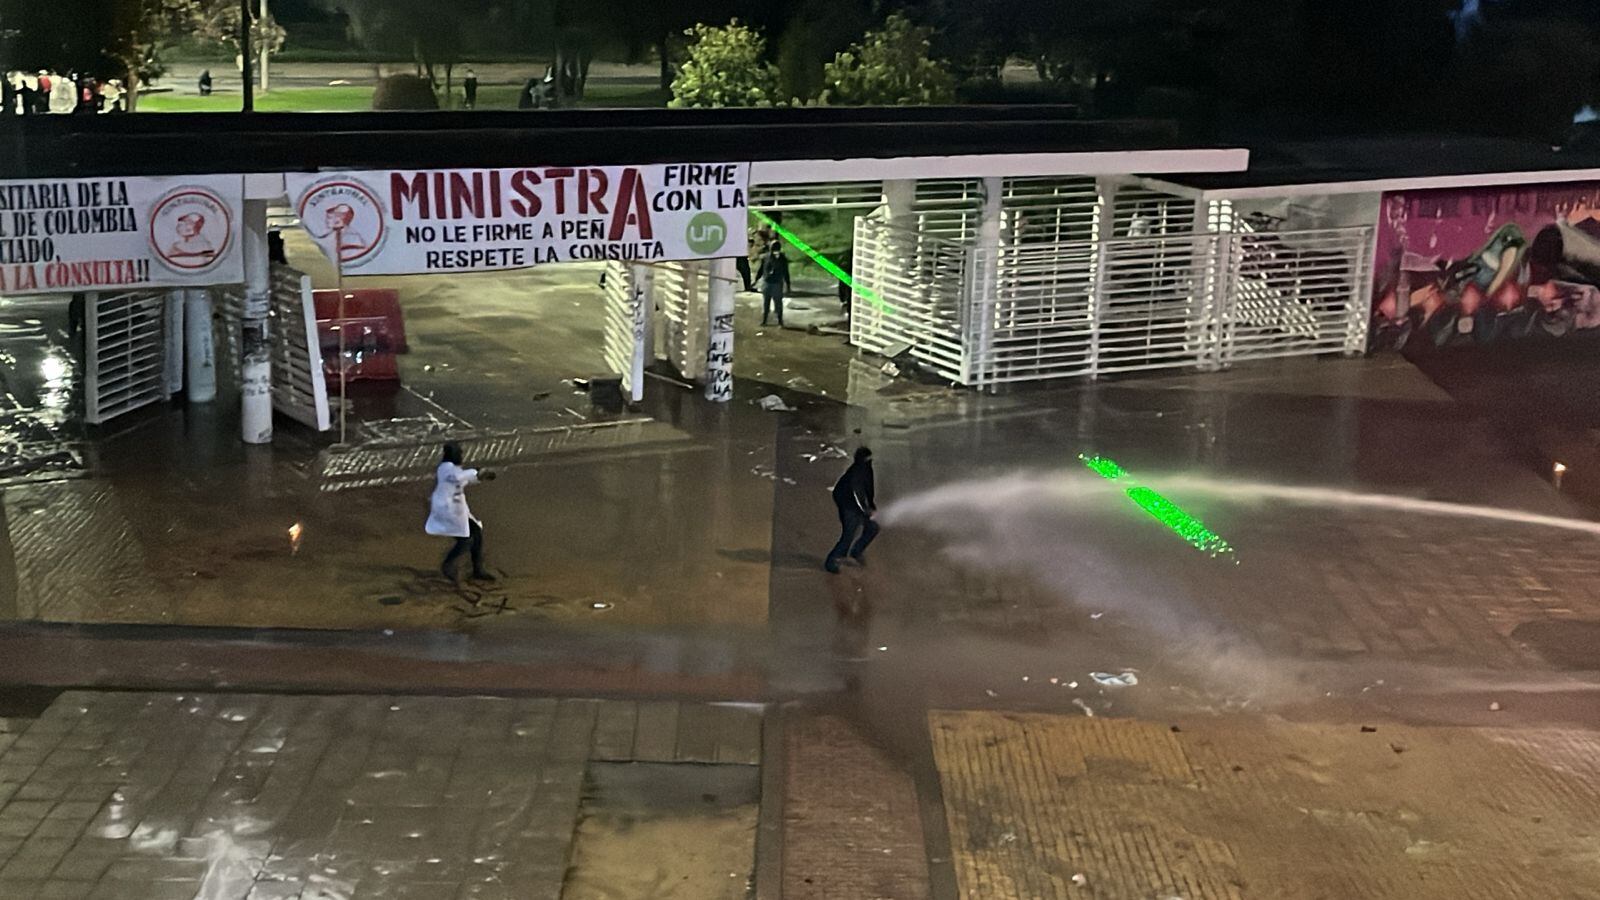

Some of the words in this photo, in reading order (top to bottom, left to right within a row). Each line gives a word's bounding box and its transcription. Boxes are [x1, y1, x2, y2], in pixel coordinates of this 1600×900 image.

[664, 164, 738, 187] FIRME
[78, 182, 101, 208] DE
[107, 181, 130, 206] LA
[390, 168, 653, 241] MINISTRA
[652, 188, 702, 212] CON
[717, 188, 745, 209] LA
[13, 211, 38, 237] DE
[44, 207, 137, 236] COLOMBIA
[406, 226, 436, 244] NO
[443, 226, 466, 243] LE
[473, 223, 533, 242] FIRME
[542, 222, 554, 239] A
[426, 248, 524, 269] RESPETE
[534, 246, 559, 264] LA
[569, 241, 664, 261] CONSULTA
[15, 264, 37, 290] LA
[45, 259, 150, 288] CONSULTA!!
